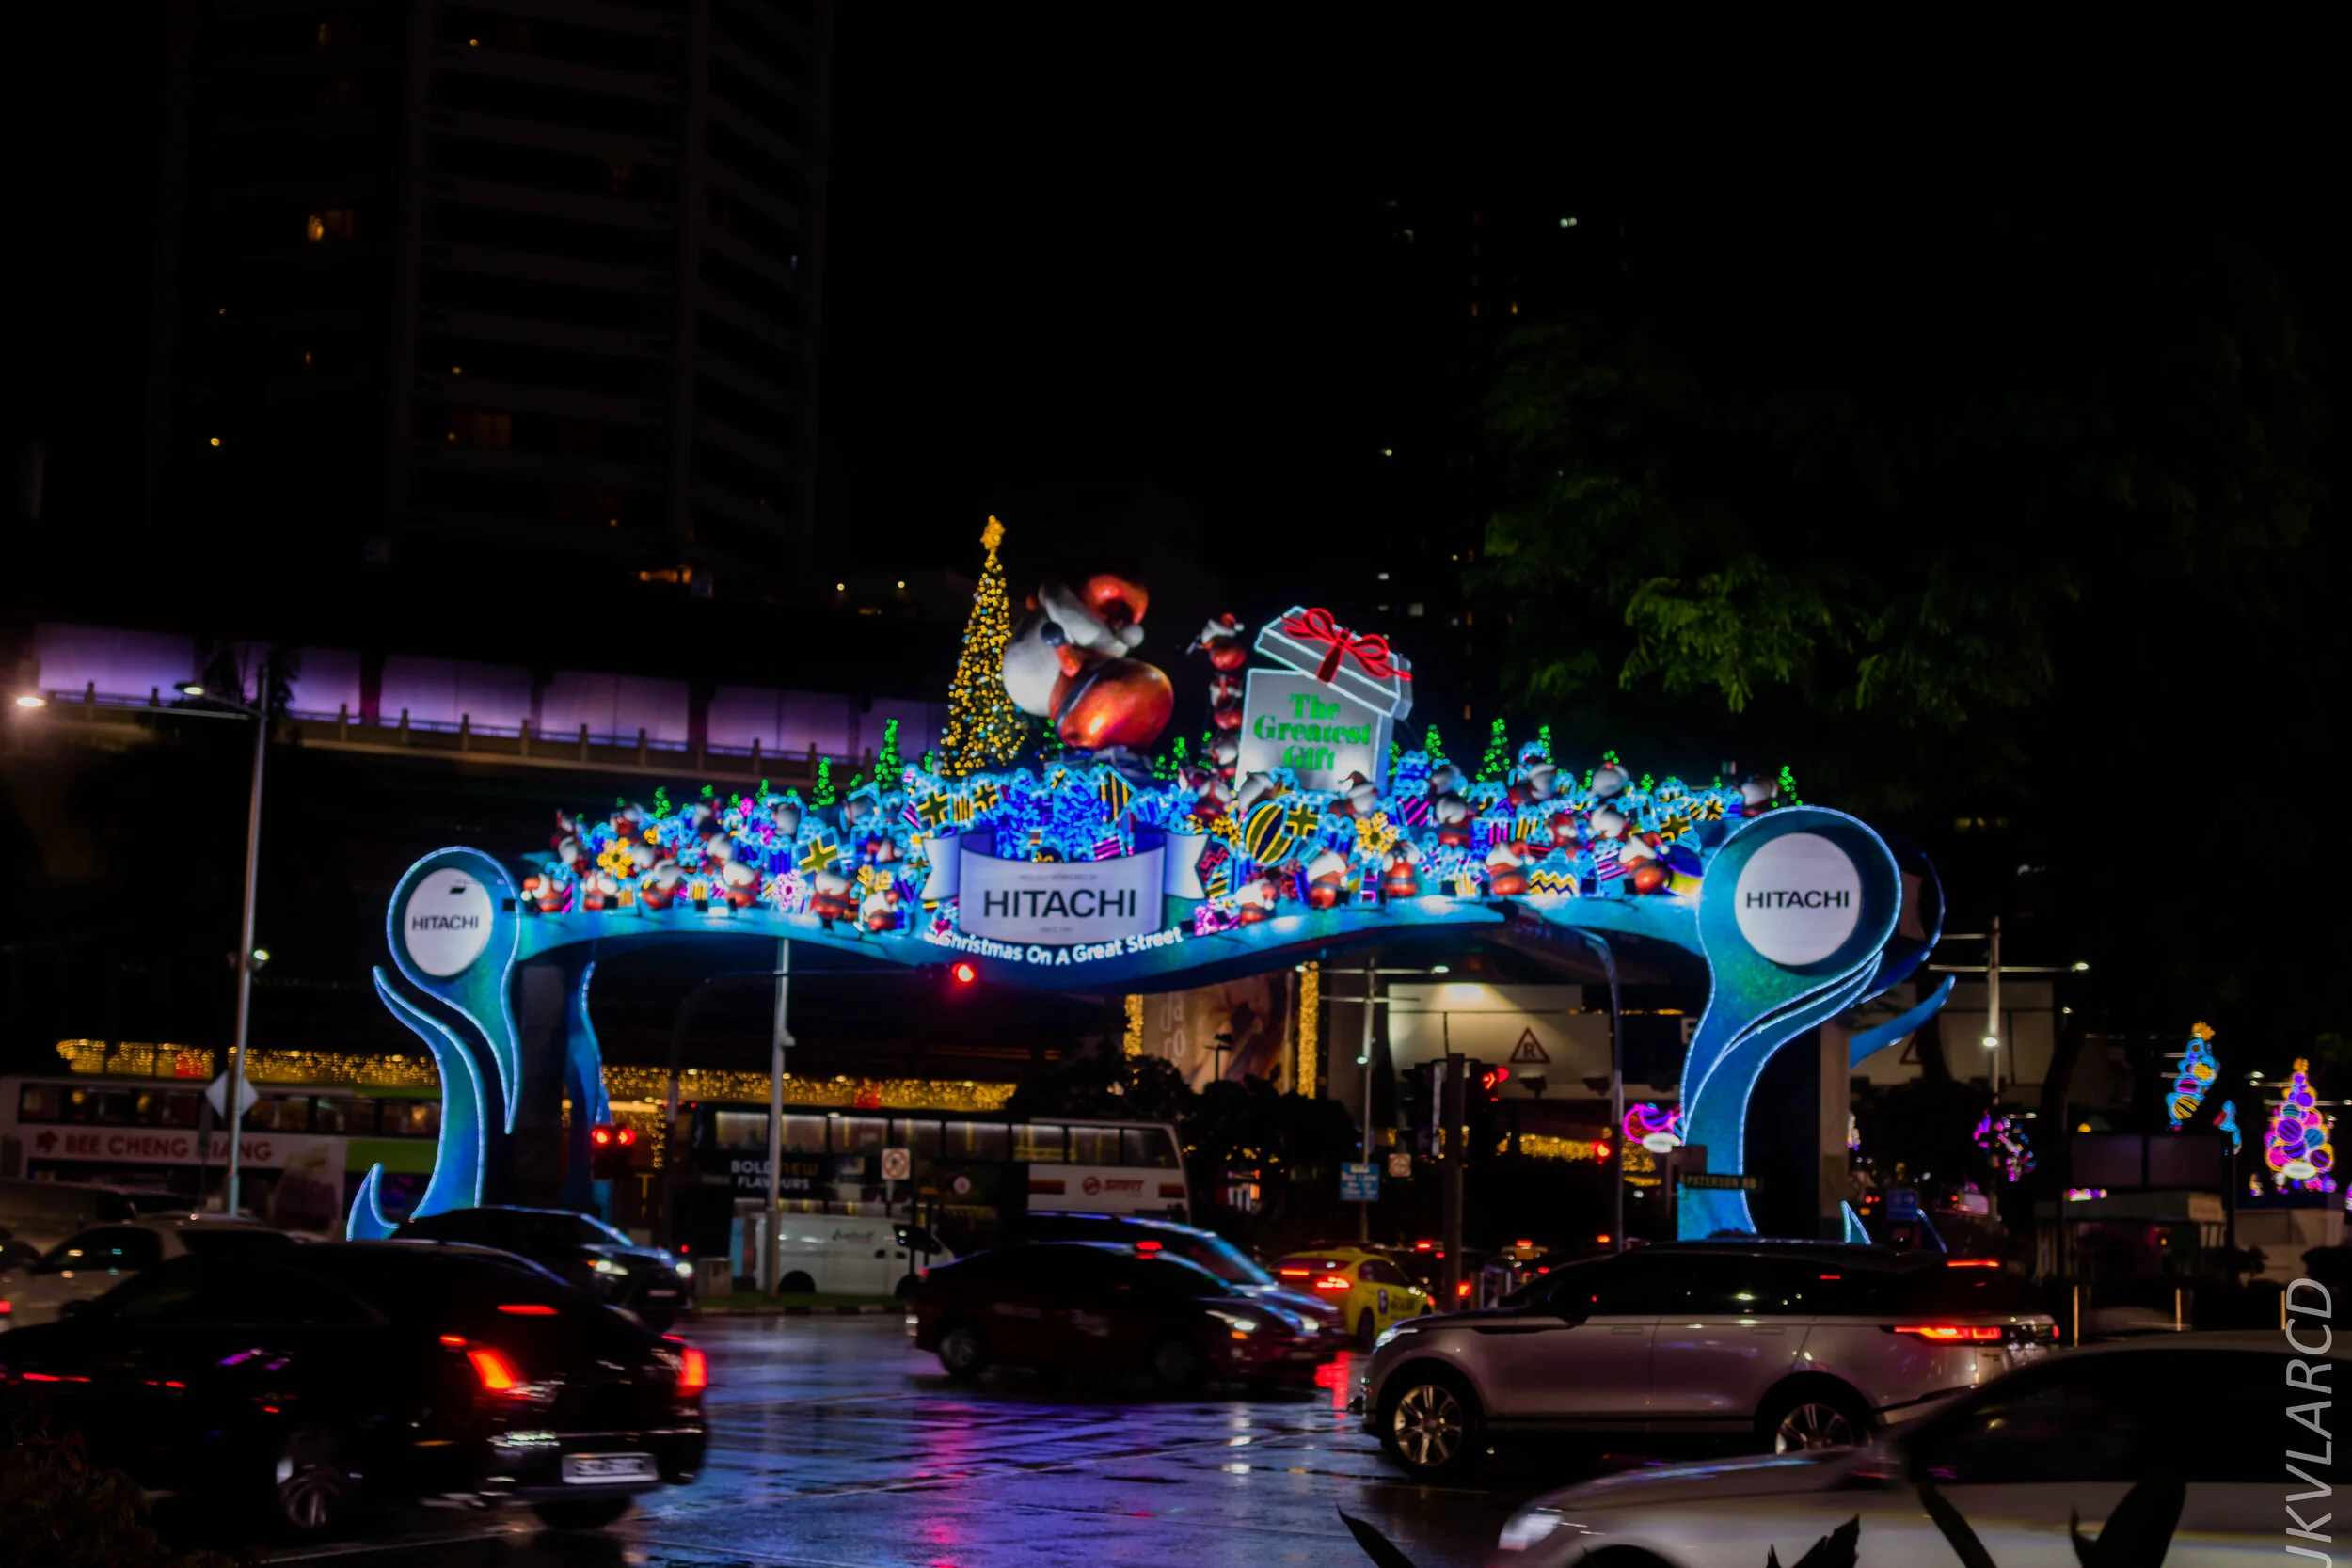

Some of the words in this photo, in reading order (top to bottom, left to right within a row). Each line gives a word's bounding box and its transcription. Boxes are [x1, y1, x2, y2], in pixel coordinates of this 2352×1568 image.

[1289, 693, 1342, 721] The
[1253, 714, 1372, 745] Greatest
[1282, 744, 1336, 771] Gift
[982, 889, 1136, 918] HITACHI
[1746, 890, 1850, 909] HITACHI
[411, 915, 480, 930] HITACHI
[1026, 944, 1053, 965] On
[1055, 947, 1071, 966] A
[1073, 941, 1124, 962] Great
[1126, 926, 1184, 954] Street
[1524, 1042, 1536, 1059] R
[65, 1134, 101, 1155] BEE
[107, 1134, 189, 1158] CHENG
[198, 1139, 272, 1162] IANG
[737, 1174, 811, 1192] FLAVURS
